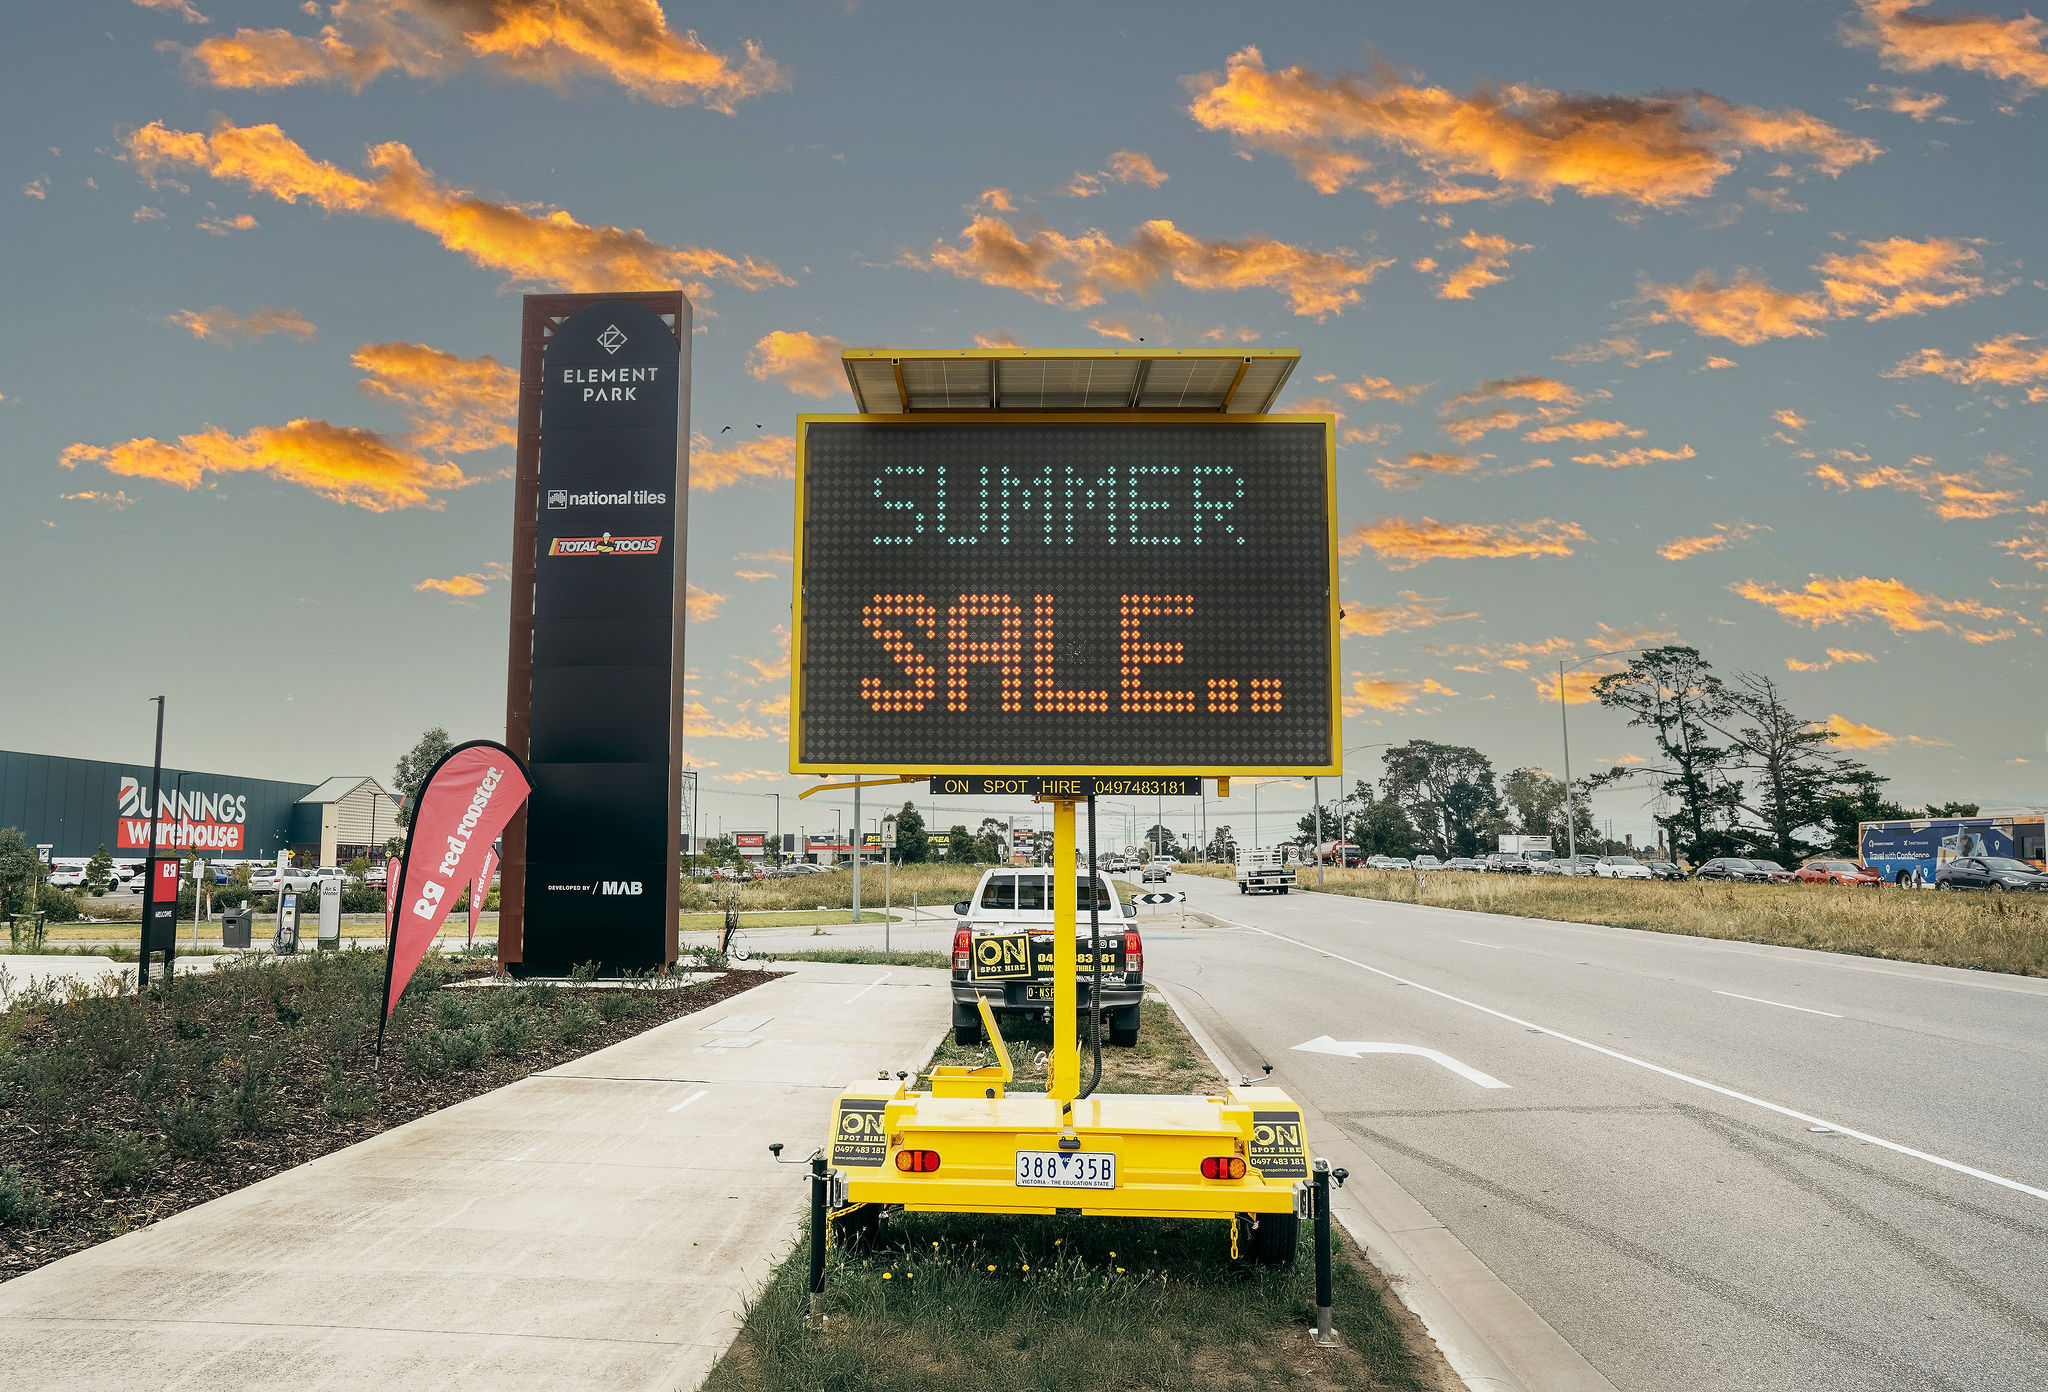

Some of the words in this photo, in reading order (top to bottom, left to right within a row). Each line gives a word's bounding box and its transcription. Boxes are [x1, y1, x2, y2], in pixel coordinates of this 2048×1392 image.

[564, 368, 658, 383] ELEMENT
[583, 387, 637, 402] PARK
[569, 490, 631, 506] national
[633, 490, 666, 505] tiles
[873, 465, 1246, 545] SUMMER
[559, 541, 597, 553] TOTAL
[614, 539, 657, 552] TOOLS
[944, 779, 969, 794] ON
[983, 780, 1029, 794] SPOT
[1042, 780, 1081, 794] HIRE
[1095, 781, 1186, 795] 0497483181
[118, 776, 247, 824] BUNNINGS
[866, 835, 881, 843] RSE
[438, 835, 467, 878] red
[1869, 851, 1885, 860] Travel
[1885, 851, 1897, 860] with
[1897, 851, 1930, 860] Confidence
[602, 881, 643, 895] MAB
[155, 910, 173, 918] WELCOME
[977, 938, 1026, 965] ON
[1005, 964, 1026, 972] HIRE
[842, 1113, 885, 1135] ON
[1253, 1125, 1299, 1146] ON
[834, 1145, 854, 1153] 0497
[1020, 1157, 1057, 1178] 388
[1075, 1158, 1111, 1180] 35B
